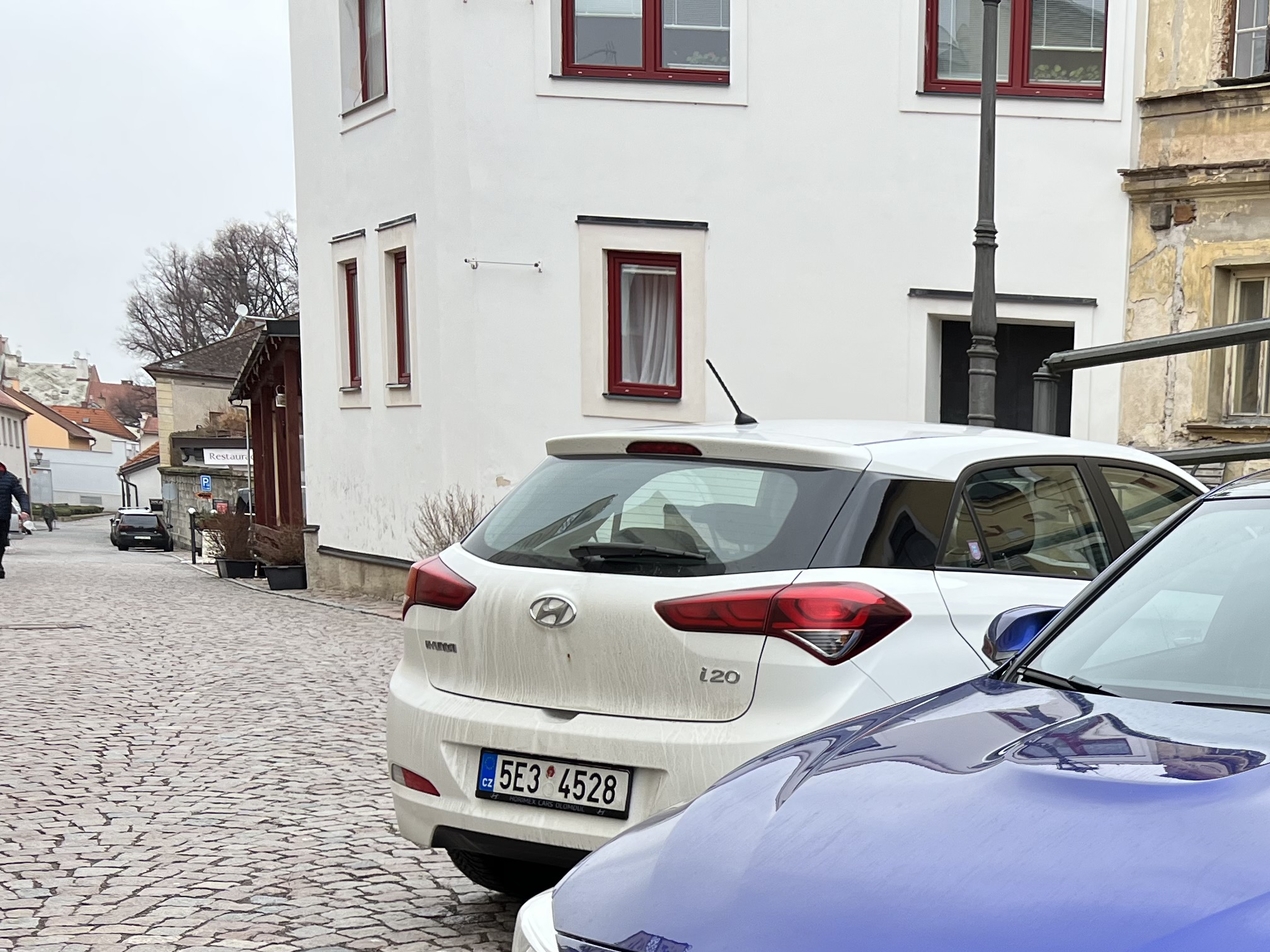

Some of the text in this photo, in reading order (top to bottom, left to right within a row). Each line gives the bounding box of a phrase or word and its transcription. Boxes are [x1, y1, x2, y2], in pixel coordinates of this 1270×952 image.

[202, 477, 209, 487] P
[700, 667, 740, 684] i20
[482, 777, 492, 787] CZ
[500, 760, 617, 804] 5E3 4528
